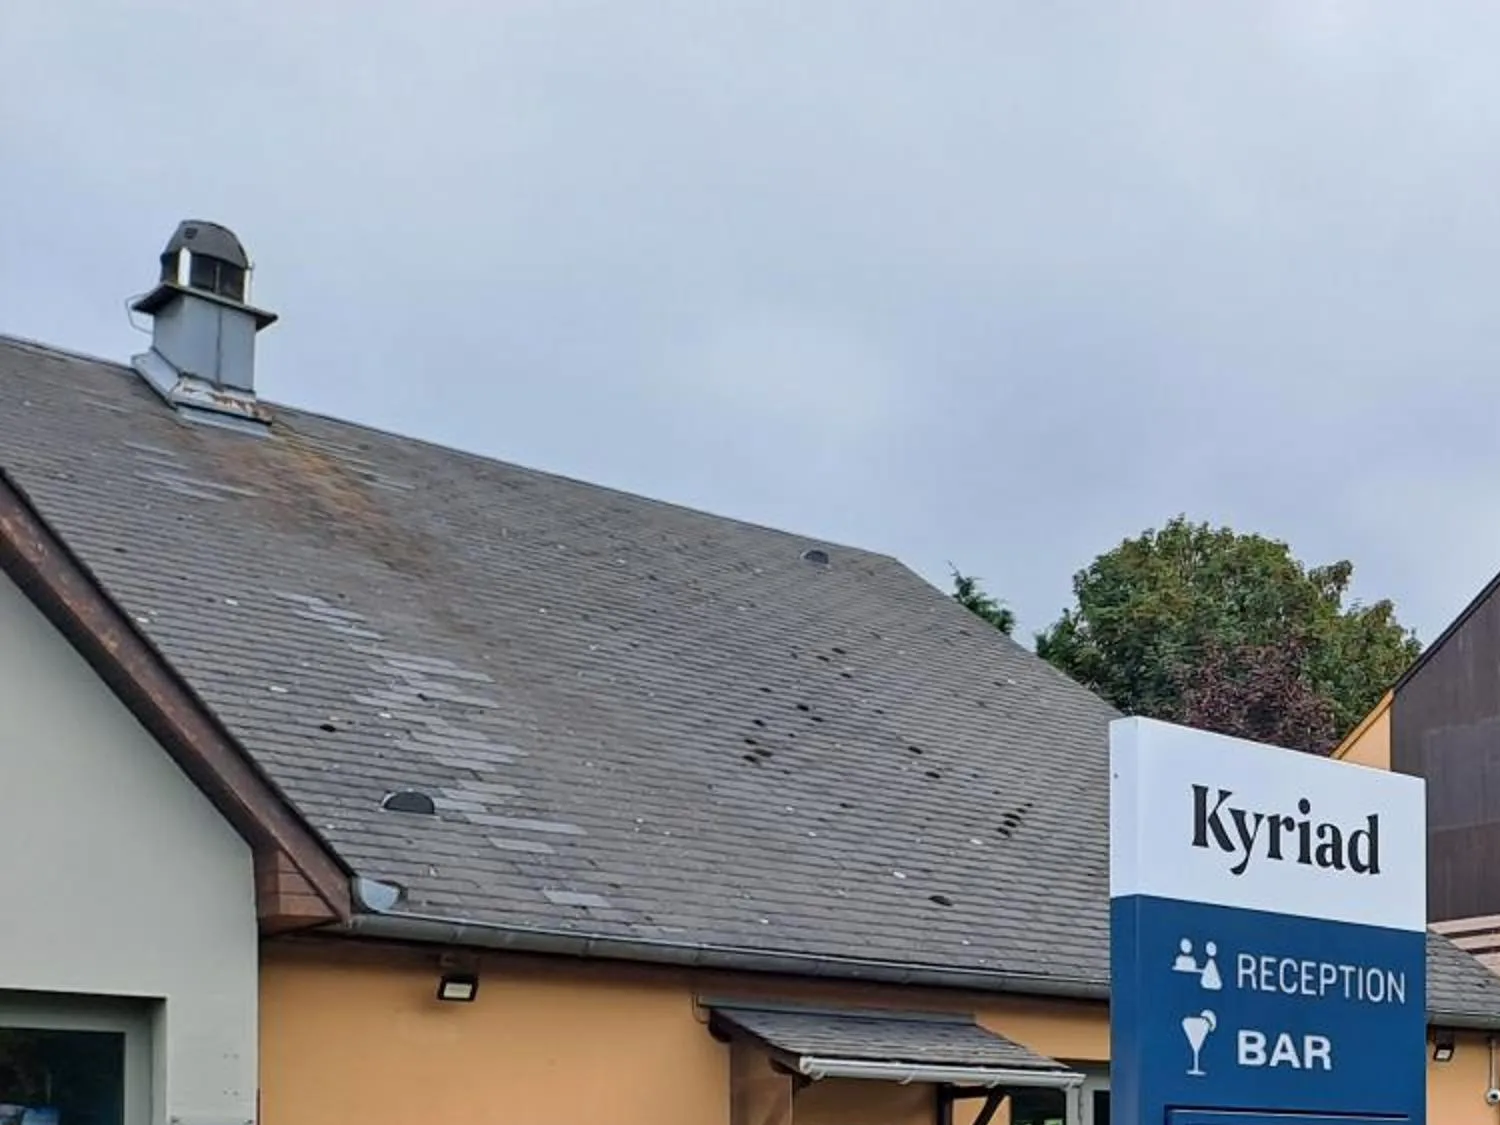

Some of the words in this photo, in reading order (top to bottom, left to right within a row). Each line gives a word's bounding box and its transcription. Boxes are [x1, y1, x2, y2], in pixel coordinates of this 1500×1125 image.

[1191, 784, 1381, 876] Kyriad
[1237, 953, 1406, 1004] RECEPTION
[1237, 1030, 1333, 1071] BAR
